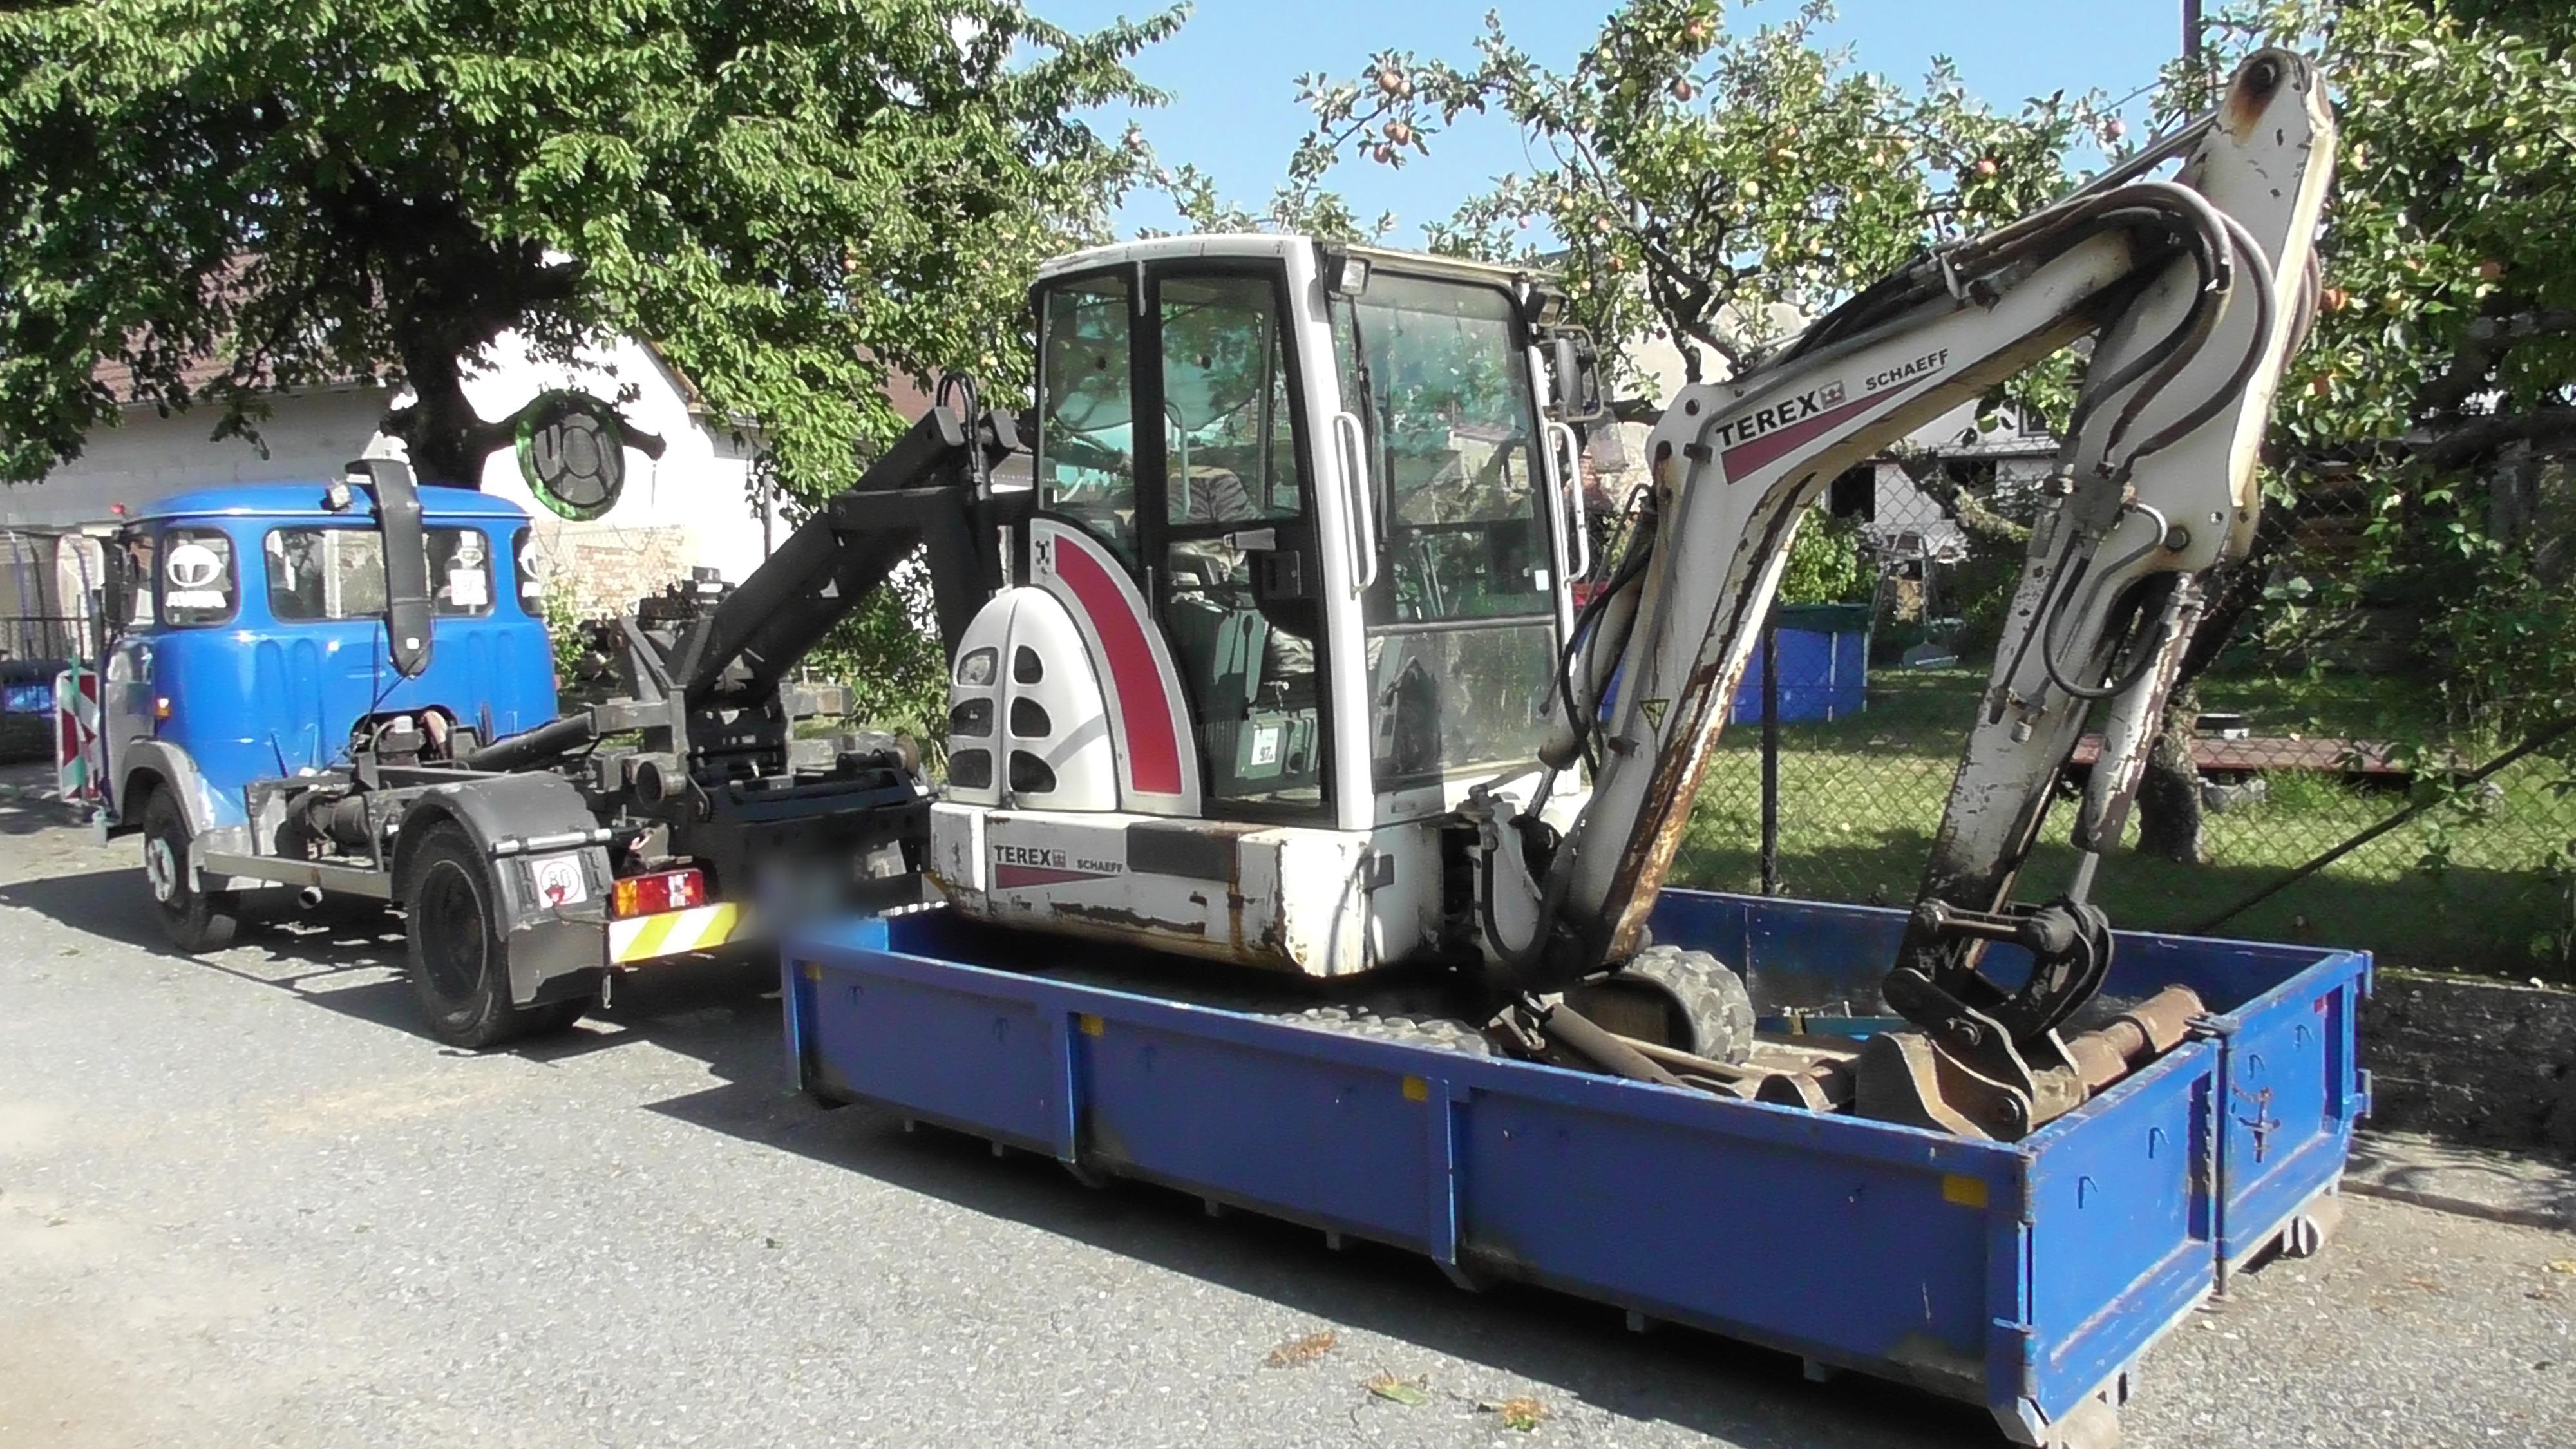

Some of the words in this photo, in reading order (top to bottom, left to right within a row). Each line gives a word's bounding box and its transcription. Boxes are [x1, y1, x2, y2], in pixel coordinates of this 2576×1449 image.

[1716, 390, 1821, 447] TEREX
[1865, 348, 1950, 392] SCHAEFF
[994, 845, 1051, 866] TEREX
[1077, 859, 1123, 873] SCHAEFF
